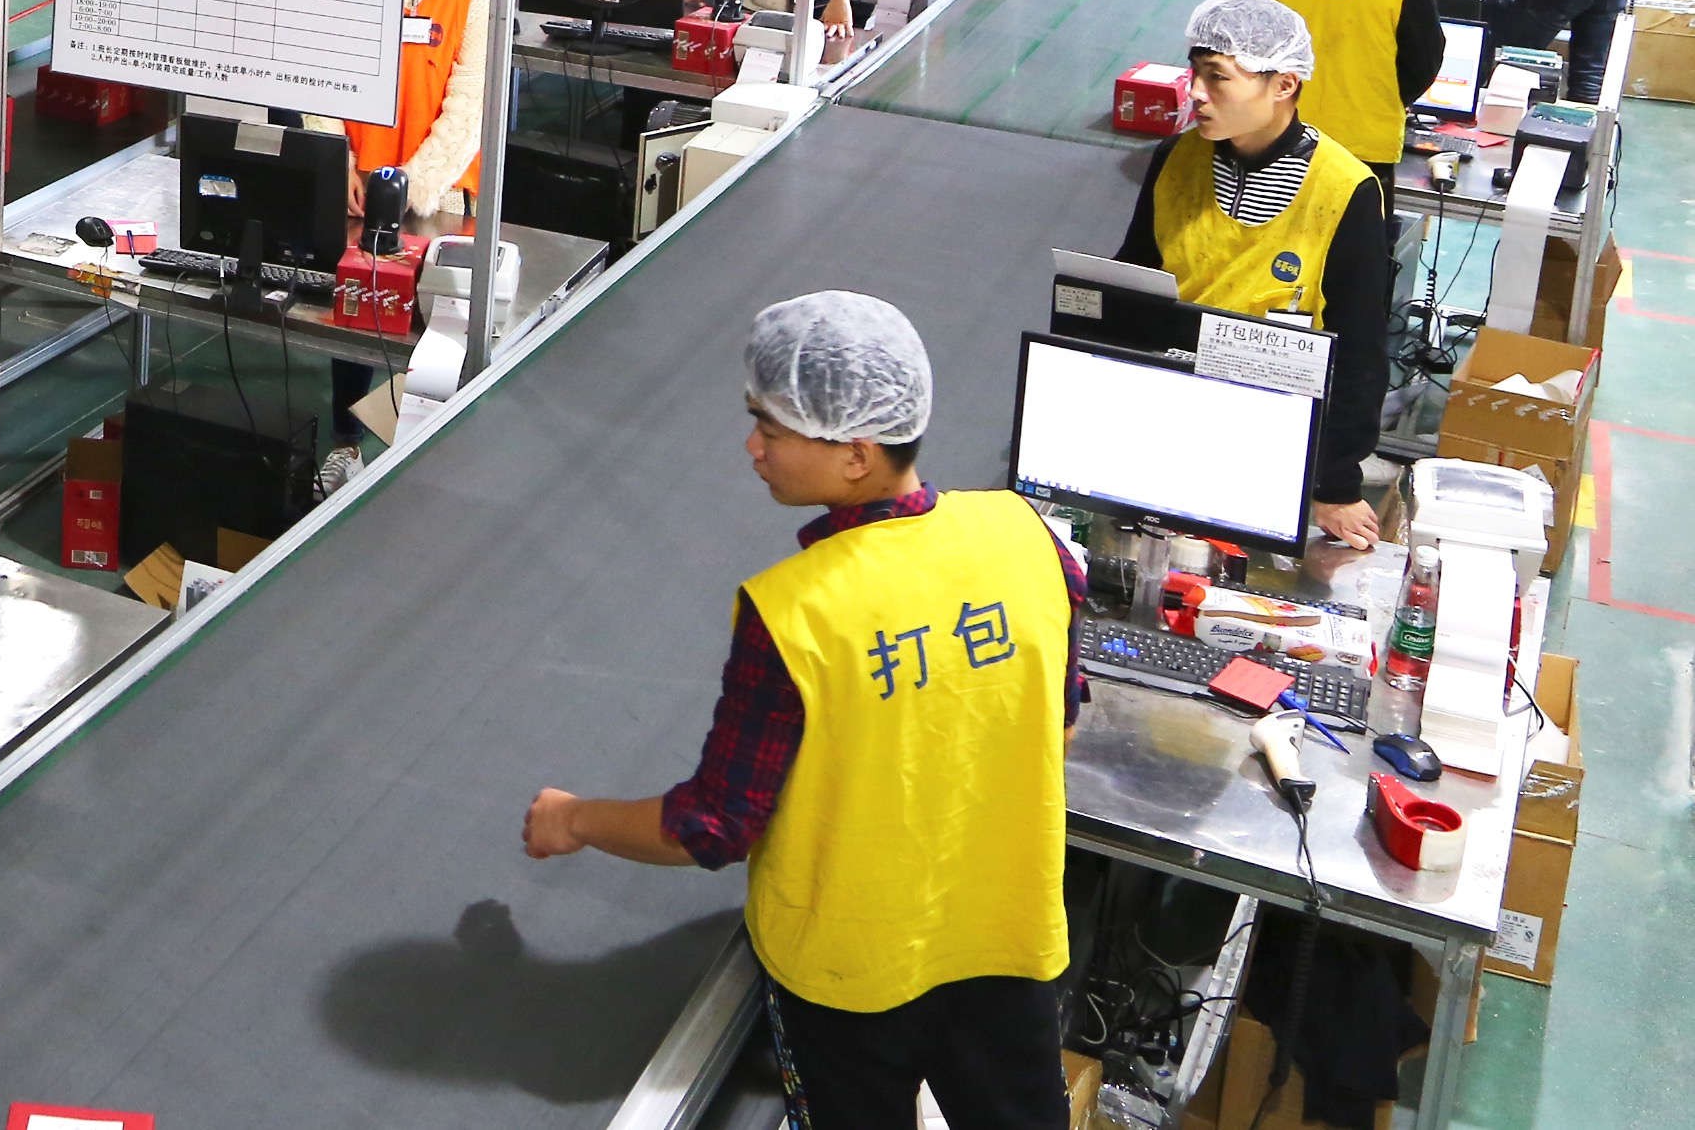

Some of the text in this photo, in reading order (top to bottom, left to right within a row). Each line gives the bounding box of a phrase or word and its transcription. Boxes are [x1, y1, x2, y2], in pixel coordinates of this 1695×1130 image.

[1215, 321, 1314, 353] 打包岗位1-04
[1144, 515, 1160, 524] AOC
[867, 601, 1016, 701] 打包
